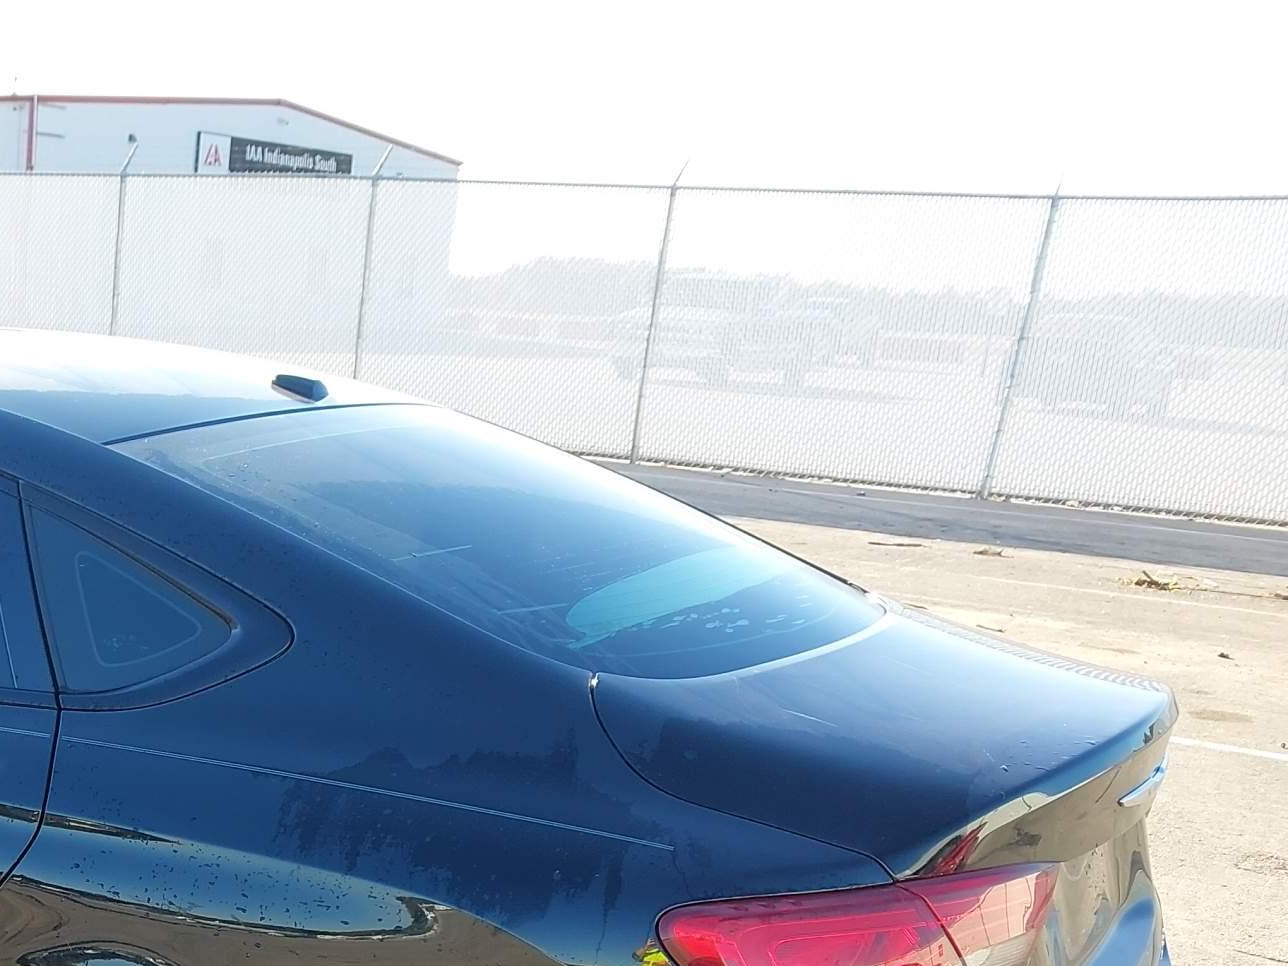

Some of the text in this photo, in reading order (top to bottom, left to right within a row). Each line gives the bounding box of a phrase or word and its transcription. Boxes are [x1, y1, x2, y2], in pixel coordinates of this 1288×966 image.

[245, 144, 337, 172] IAA Indianapolis South
